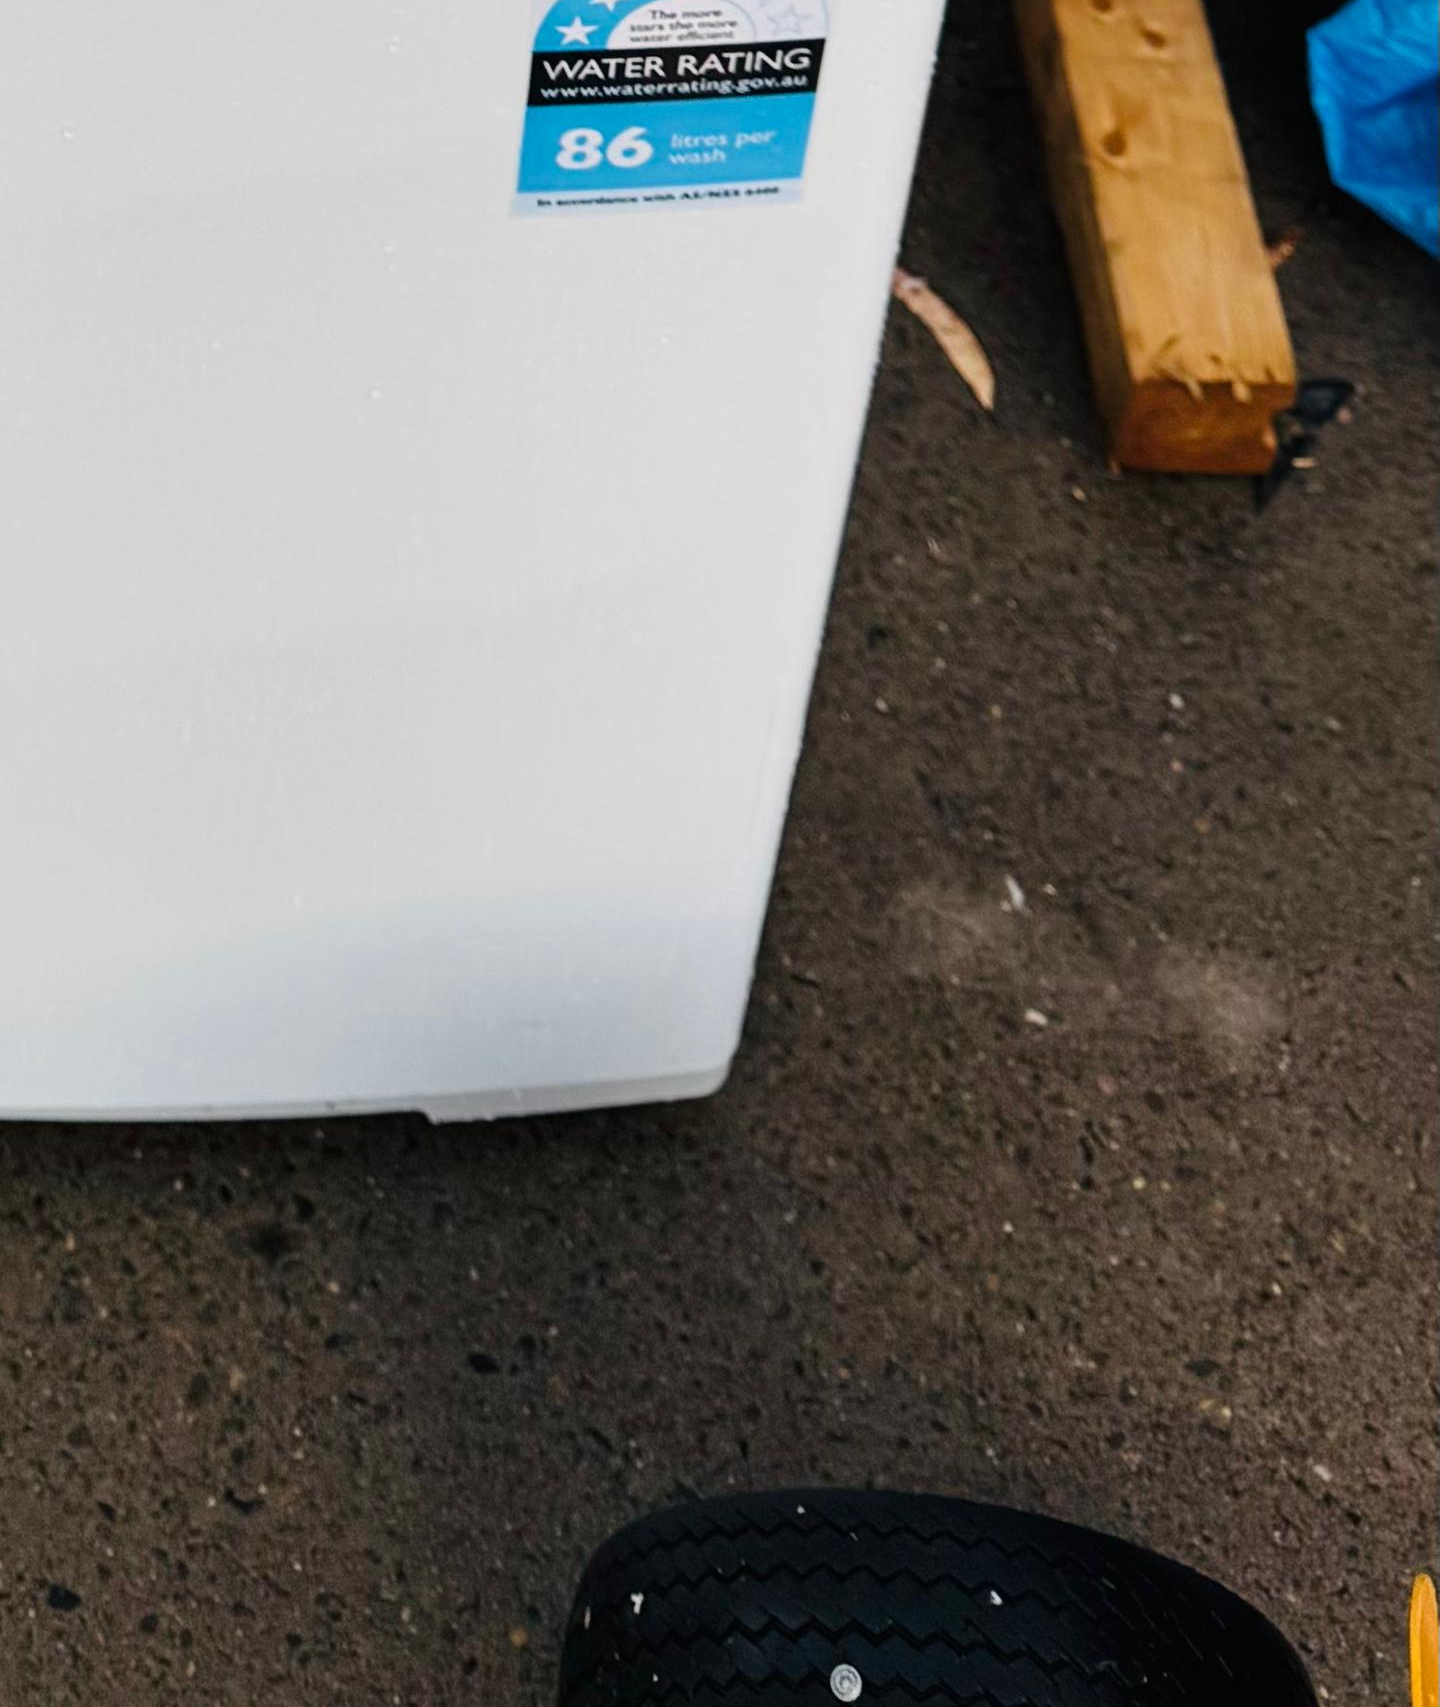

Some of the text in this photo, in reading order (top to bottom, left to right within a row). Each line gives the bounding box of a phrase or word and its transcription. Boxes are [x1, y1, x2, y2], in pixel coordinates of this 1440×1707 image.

[649, 9, 723, 20] The more
[630, 19, 738, 32] stars the more
[630, 34, 672, 43] water
[543, 48, 812, 80] WATER RATING
[540, 74, 808, 100] www.waterrating.gov.au
[555, 125, 654, 170] 86
[671, 130, 777, 150] litres per
[668, 149, 726, 165] wash
